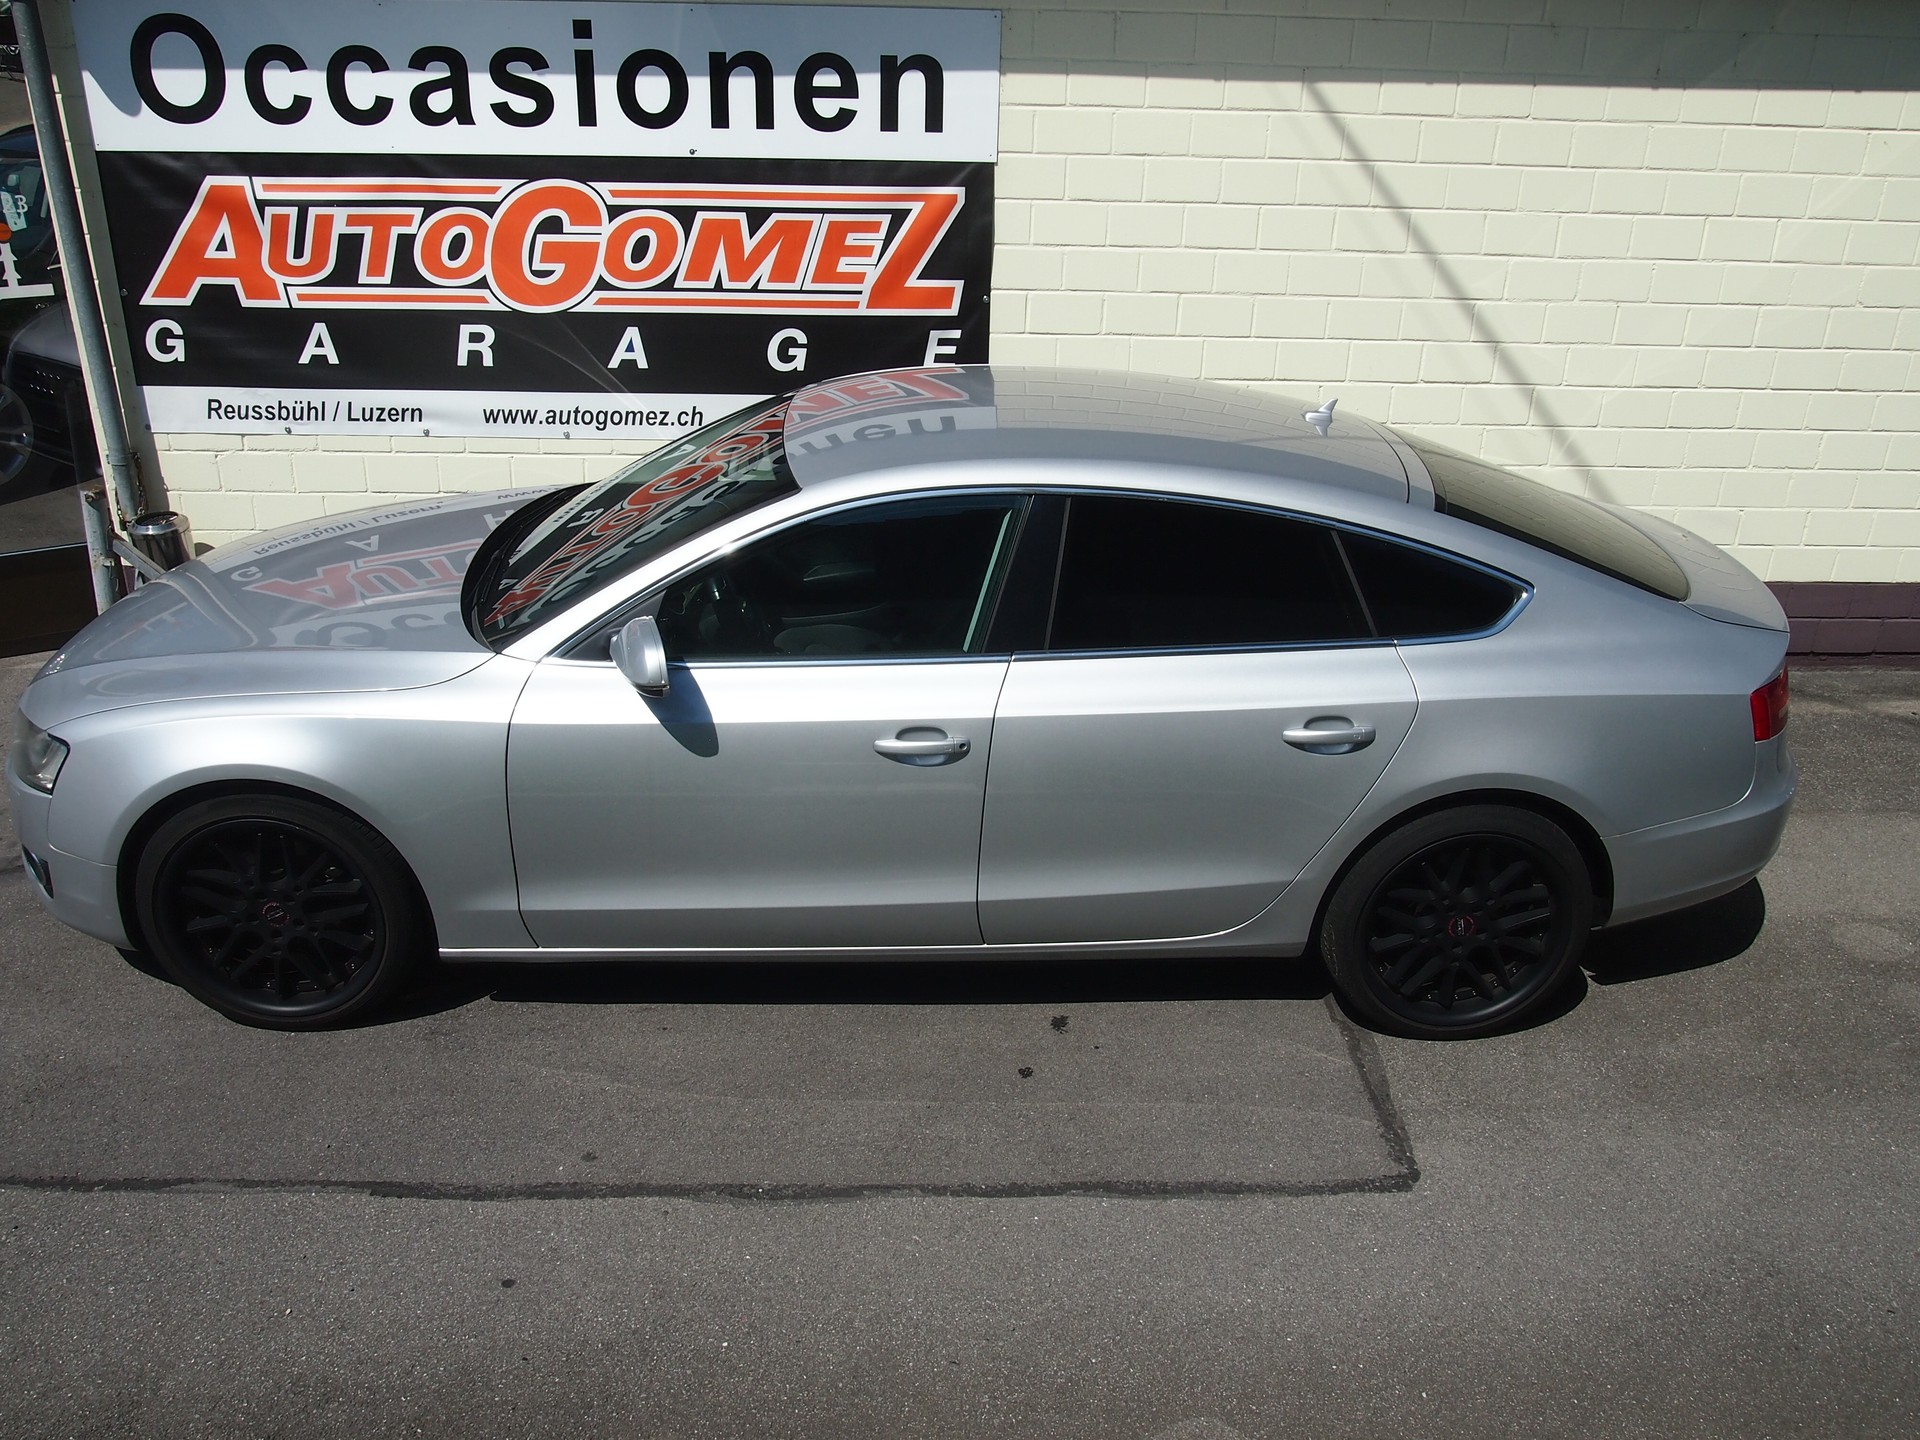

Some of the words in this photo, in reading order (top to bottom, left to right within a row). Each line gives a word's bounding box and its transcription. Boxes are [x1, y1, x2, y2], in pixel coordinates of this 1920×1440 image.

[130, 13, 944, 132] Occasionen
[207, 398, 326, 422] Reussbühl
[332, 400, 341, 422] /
[347, 401, 423, 423] Luzern
[483, 405, 704, 431] www.autogomez.ch
